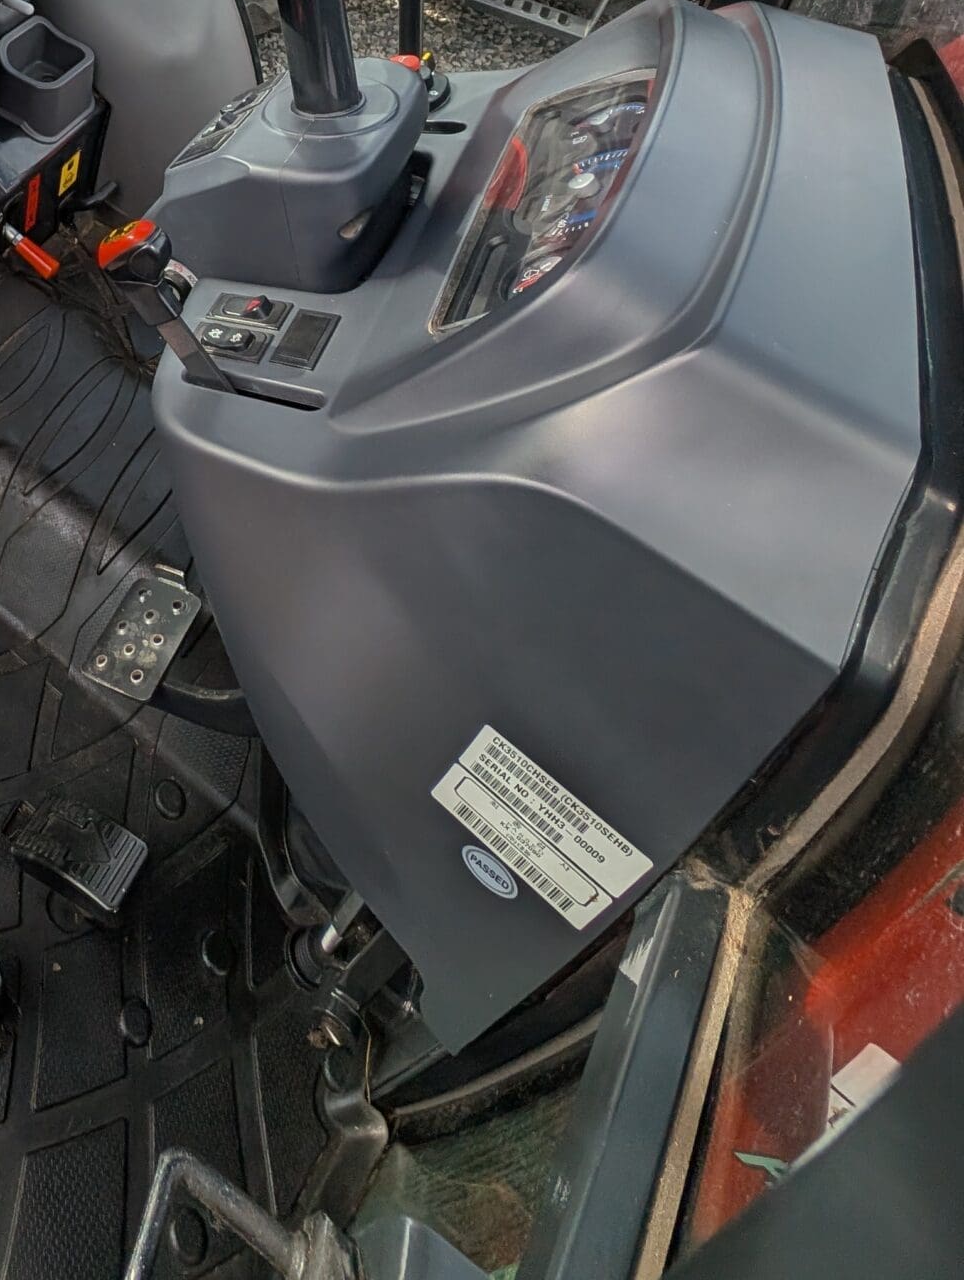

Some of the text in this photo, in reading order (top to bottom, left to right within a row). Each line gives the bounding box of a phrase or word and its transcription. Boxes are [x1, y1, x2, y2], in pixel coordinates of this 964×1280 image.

[479, 753, 512, 785] SERIAL
[514, 783, 529, 798] NO
[492, 736, 560, 794] CK3510CHSEB
[560, 794, 633, 857] (CK3510SEHB)
[469, 853, 510, 890] PASSED
